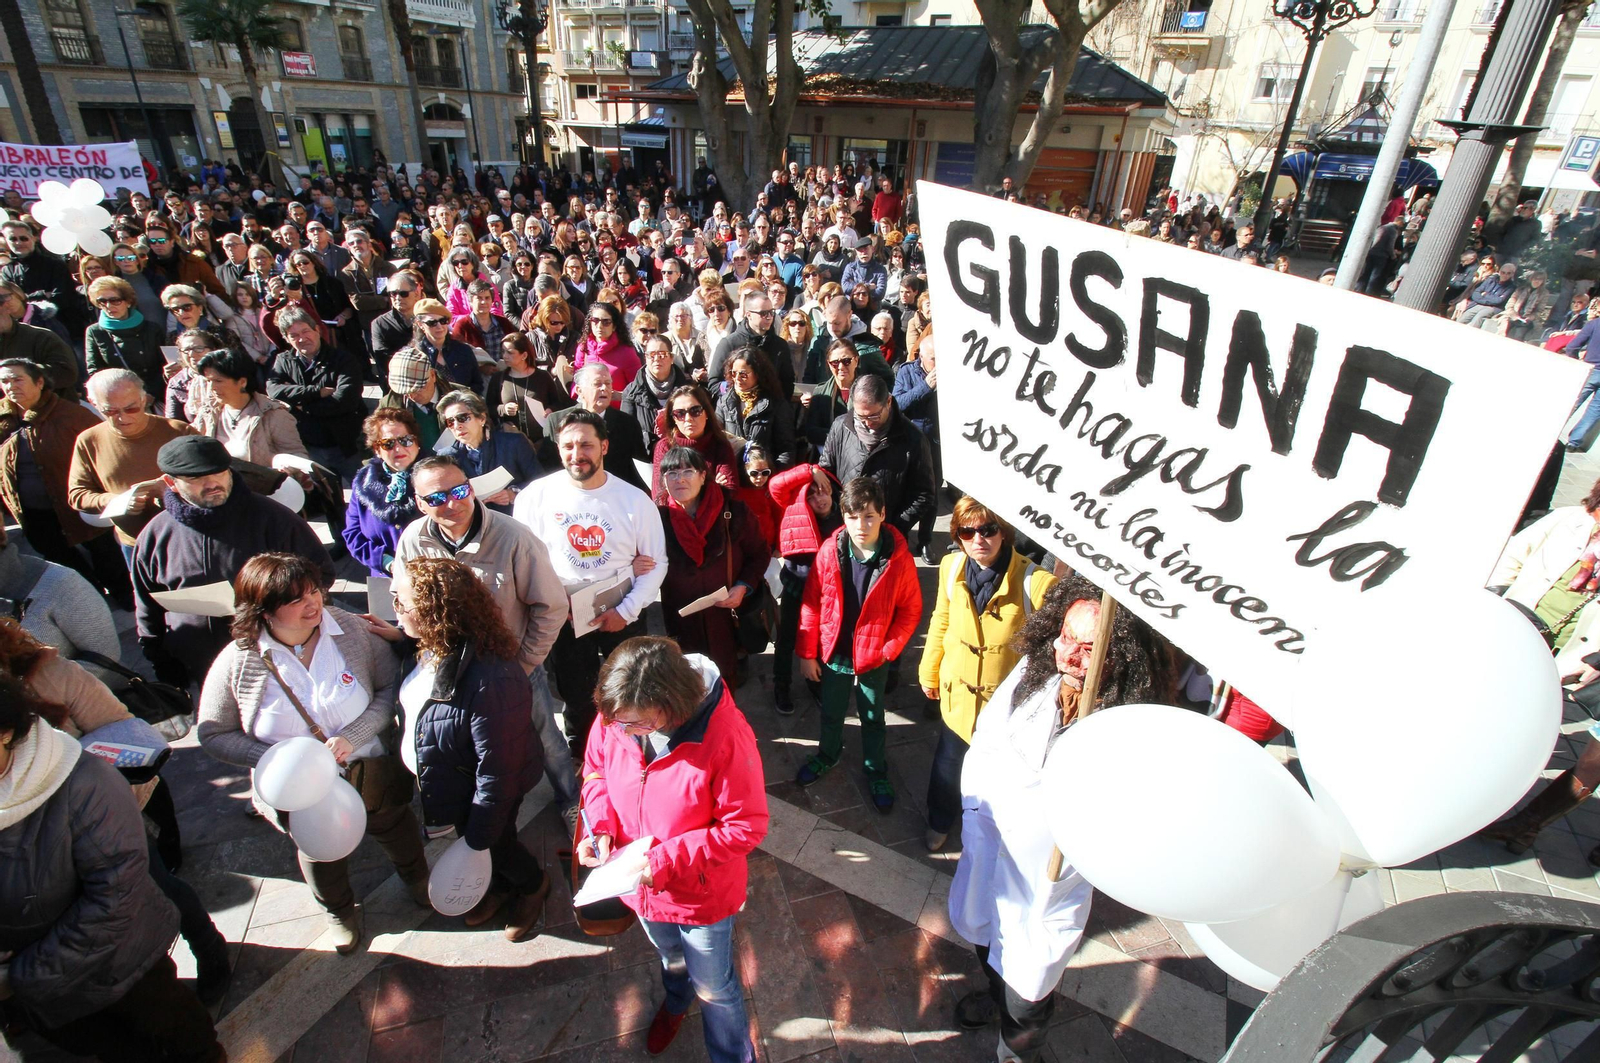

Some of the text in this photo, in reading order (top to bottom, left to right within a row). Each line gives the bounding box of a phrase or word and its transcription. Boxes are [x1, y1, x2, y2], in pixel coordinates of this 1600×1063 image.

[45, 165, 115, 179] CENTRO
[119, 165, 143, 179] DE
[944, 219, 1453, 508] GUSANA
[962, 329, 1410, 592] no te hagas la
[962, 418, 1062, 493] sorda
[1071, 491, 1113, 529] ni
[1119, 508, 1165, 560] la
[586, 512, 599, 523] POR
[570, 532, 602, 547] Yeah!!
[592, 551, 612, 568] DIGNA
